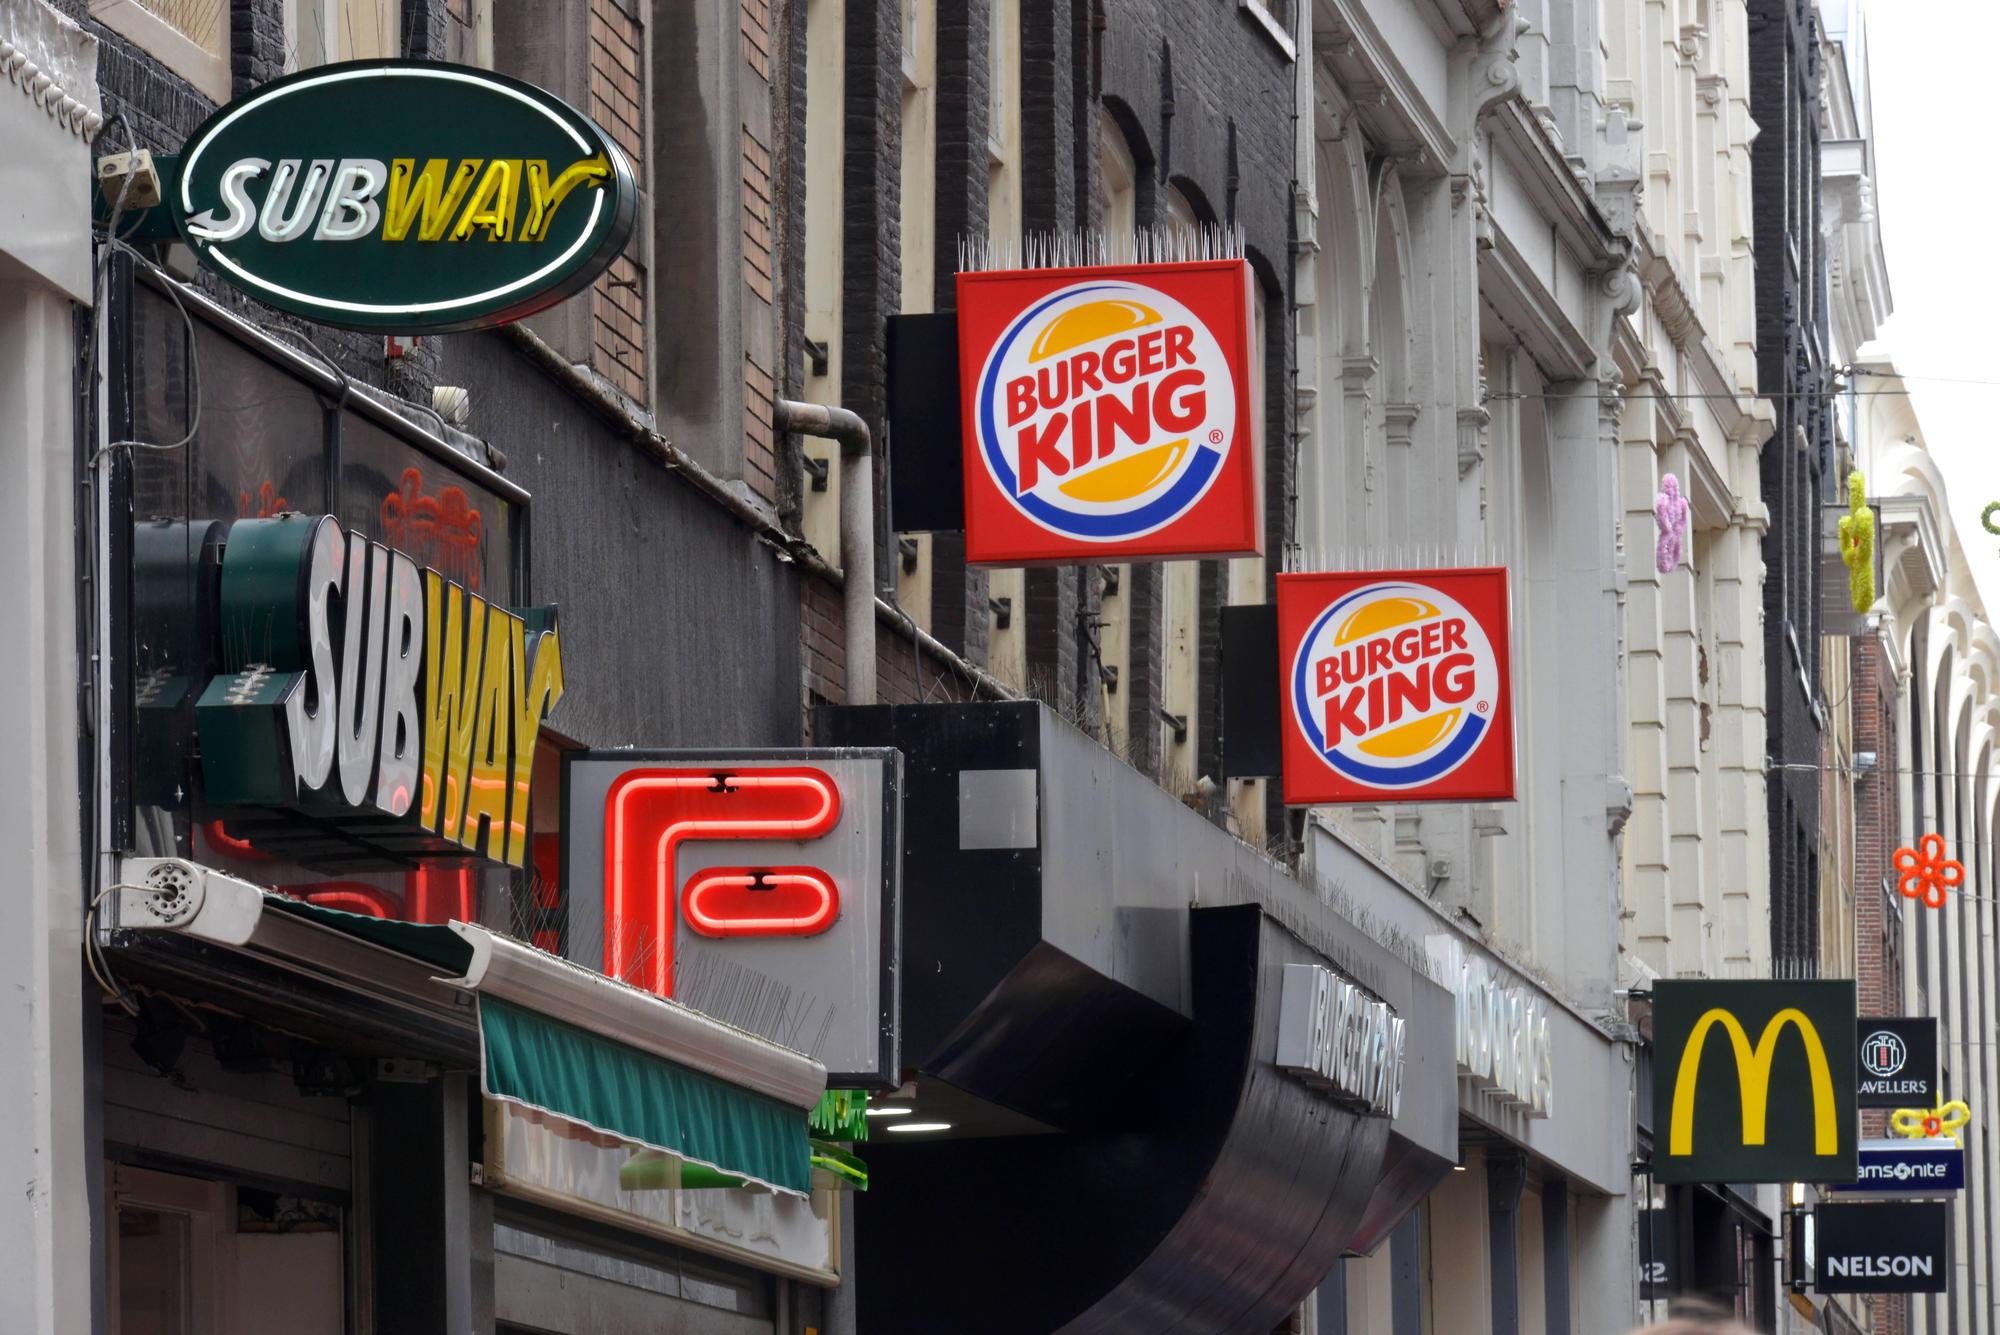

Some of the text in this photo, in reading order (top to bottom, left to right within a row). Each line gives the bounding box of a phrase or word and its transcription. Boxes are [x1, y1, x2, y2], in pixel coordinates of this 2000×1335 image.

[185, 150, 616, 247] SUBWAY
[1005, 324, 1196, 429] BURGER
[1016, 369, 1207, 494] KING
[283, 513, 565, 868] SUBWAY
[1316, 617, 1468, 698] BURGER
[1324, 652, 1475, 752] KING
[1858, 1080, 1928, 1094] AVELLERS
[1858, 1163, 1947, 1180] amsonite
[1827, 1256, 1933, 1277] NELSON
